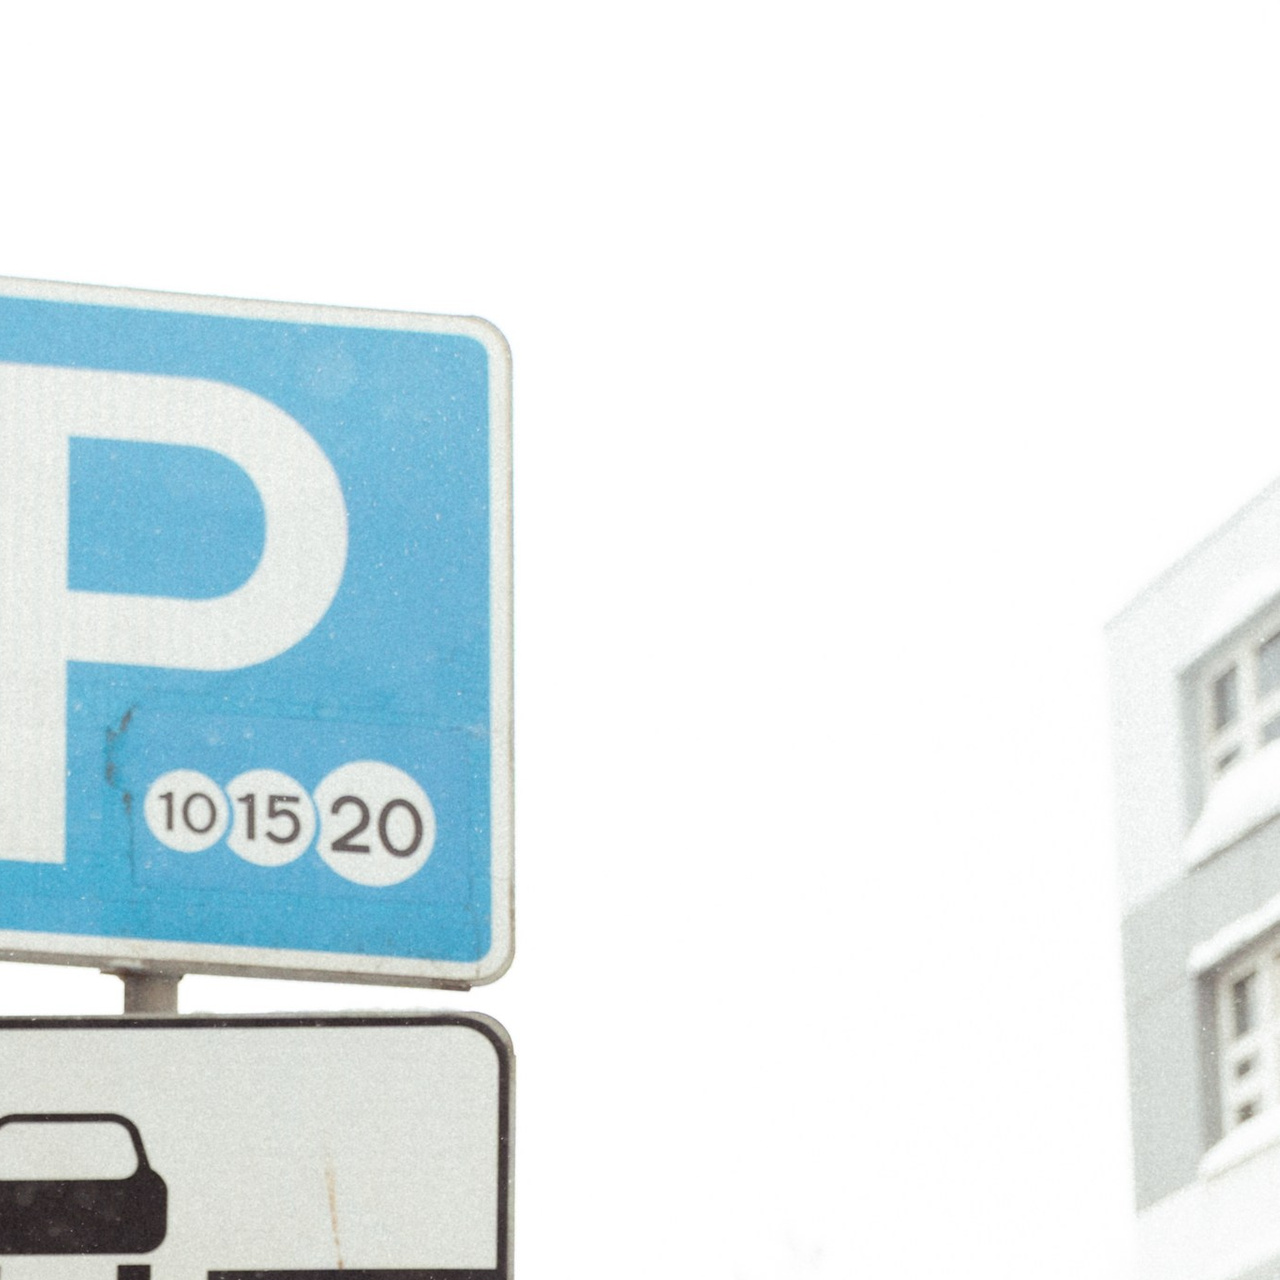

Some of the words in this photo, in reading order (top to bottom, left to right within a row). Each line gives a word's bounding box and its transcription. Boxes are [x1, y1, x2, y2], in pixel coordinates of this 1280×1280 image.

[158, 791, 217, 834] 10
[237, 793, 301, 845] 15
[331, 794, 424, 858] 20
